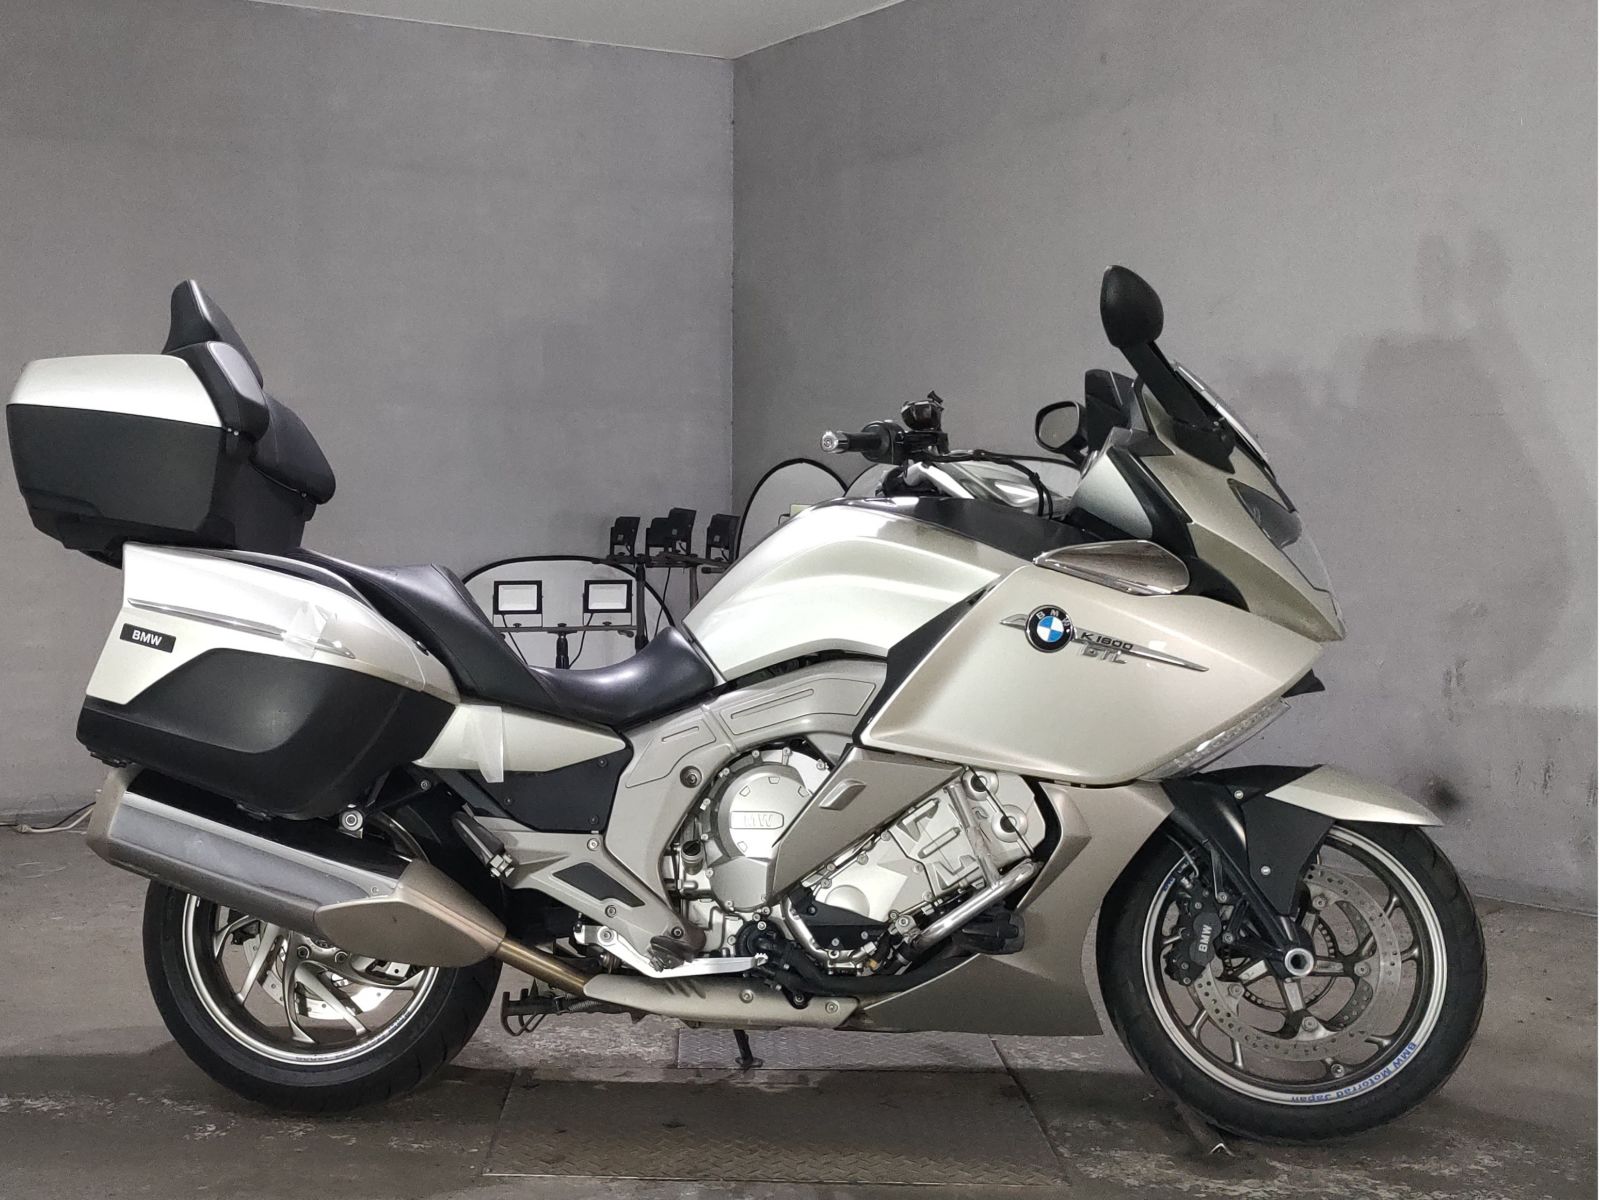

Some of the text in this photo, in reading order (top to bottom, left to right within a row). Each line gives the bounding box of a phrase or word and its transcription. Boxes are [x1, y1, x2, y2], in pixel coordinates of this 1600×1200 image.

[1035, 609, 1071, 626] BMW
[132, 629, 162, 646] BMW
[1081, 632, 1094, 641] K
[1198, 924, 1213, 953] BMW
[1291, 1042, 1418, 1103] BMW Motorrad Japan
